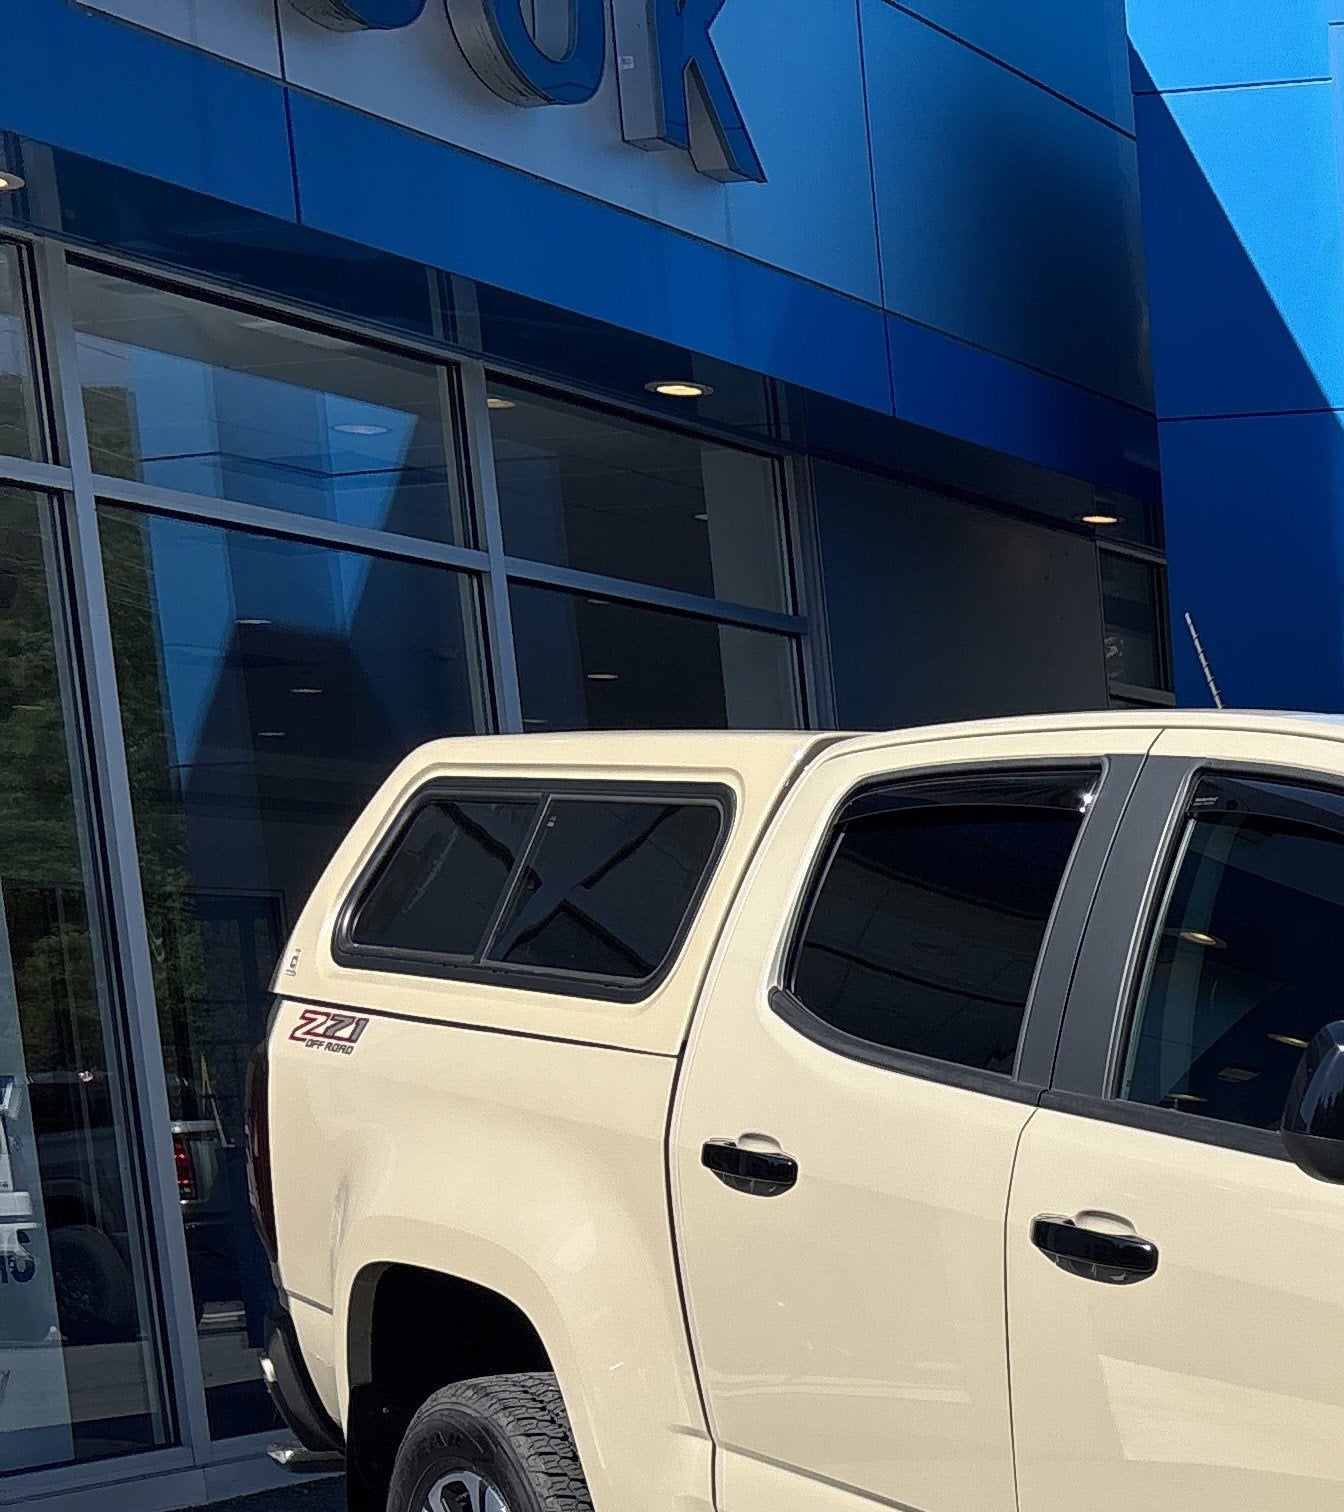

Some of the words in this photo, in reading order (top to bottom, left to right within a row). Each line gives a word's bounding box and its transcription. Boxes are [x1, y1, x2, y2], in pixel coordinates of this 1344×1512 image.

[288, 1008, 370, 1044] Z71
[305, 1038, 325, 1049] OFF
[324, 1041, 355, 1056] ROAD
